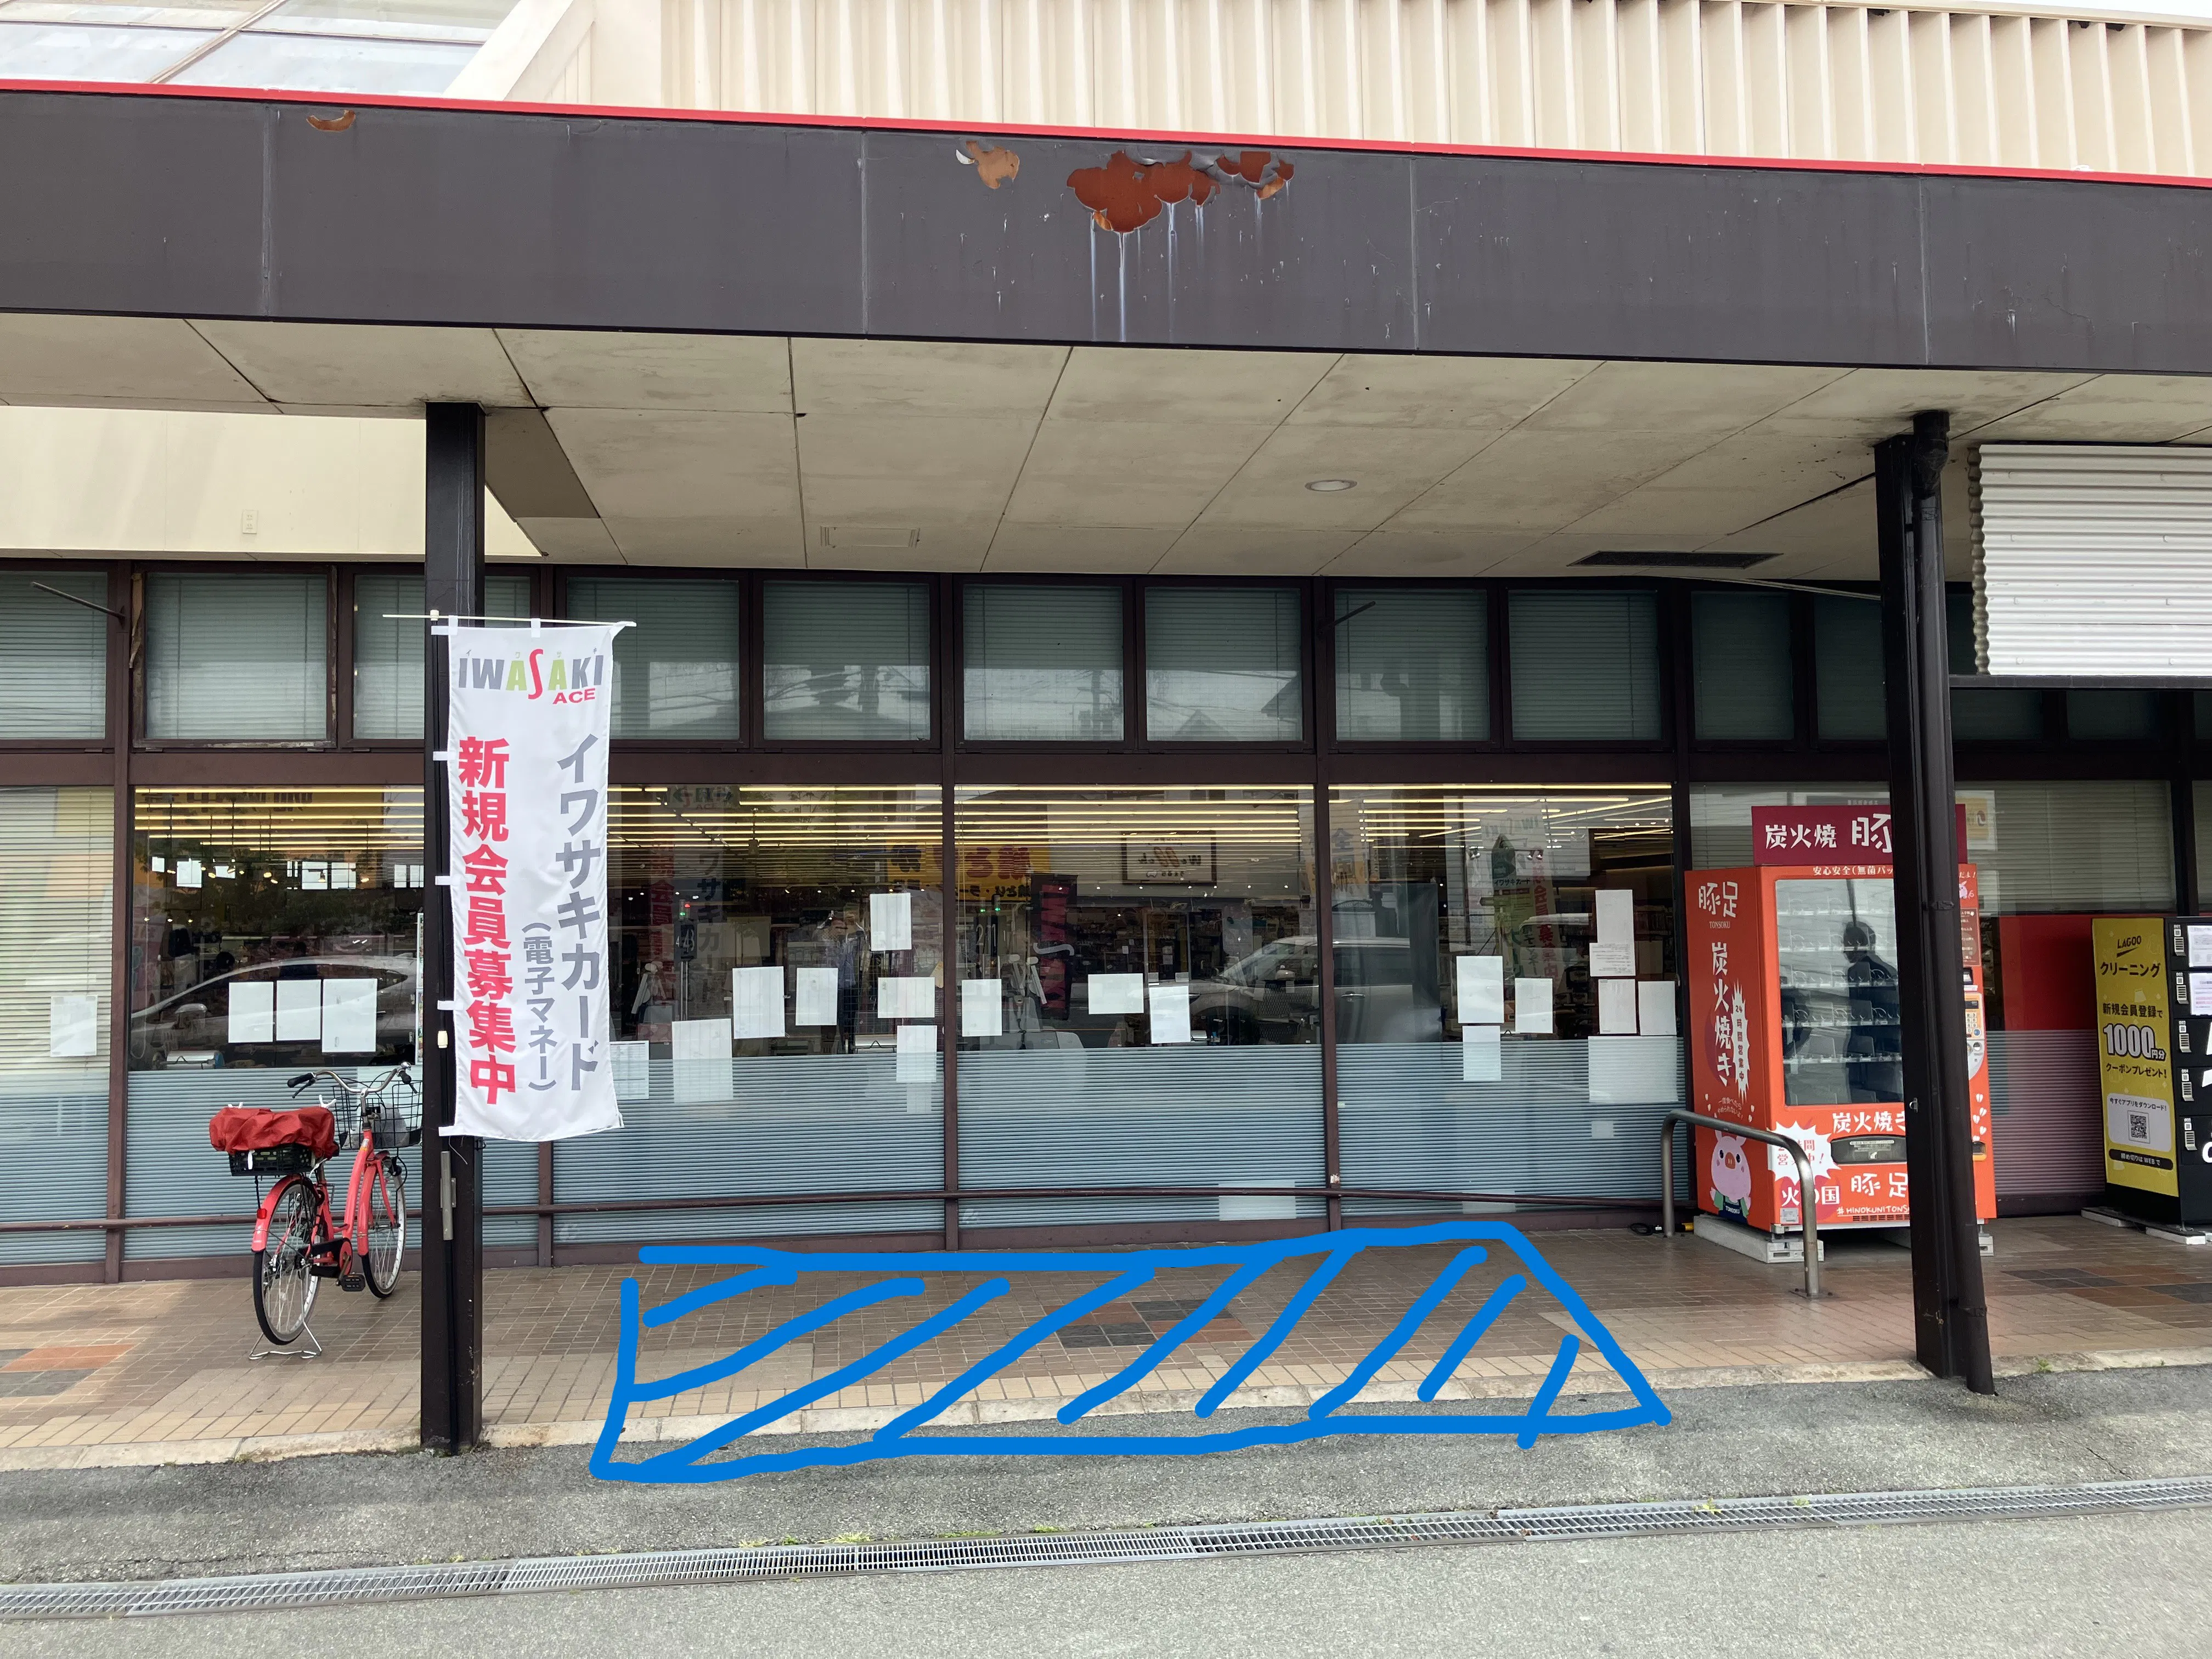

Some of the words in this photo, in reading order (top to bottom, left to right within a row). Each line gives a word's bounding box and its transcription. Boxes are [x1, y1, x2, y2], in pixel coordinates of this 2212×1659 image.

[459, 648, 604, 699] IWASAKI
[552, 688, 596, 704] ACE
[1765, 824, 1837, 849] 炭火焼
[1699, 881, 1738, 918] 豚足
[458, 736, 517, 1104] 新規会員募集中
[555, 733, 601, 1091] イワサキカード
[1709, 921, 1731, 929] TONSOKU
[2117, 935, 2142, 949] LAGOO
[2100, 961, 2161, 978] クリーニング
[1712, 941, 1732, 1087] 炭火焼き
[2103, 1002, 2163, 1018] 新規会員登録で
[2103, 1023, 2166, 1062] 1000円分
[2106, 1063, 2168, 1079] クーポンプレゼント!
[2109, 1097, 2167, 1111] 今すぐアプリをダウンロード!
[1832, 1111, 1905, 1133] 炭火焼き
[1851, 1172, 1908, 1198] 豚足
[1837, 1205, 1910, 1214] #HINOKUNITONS
